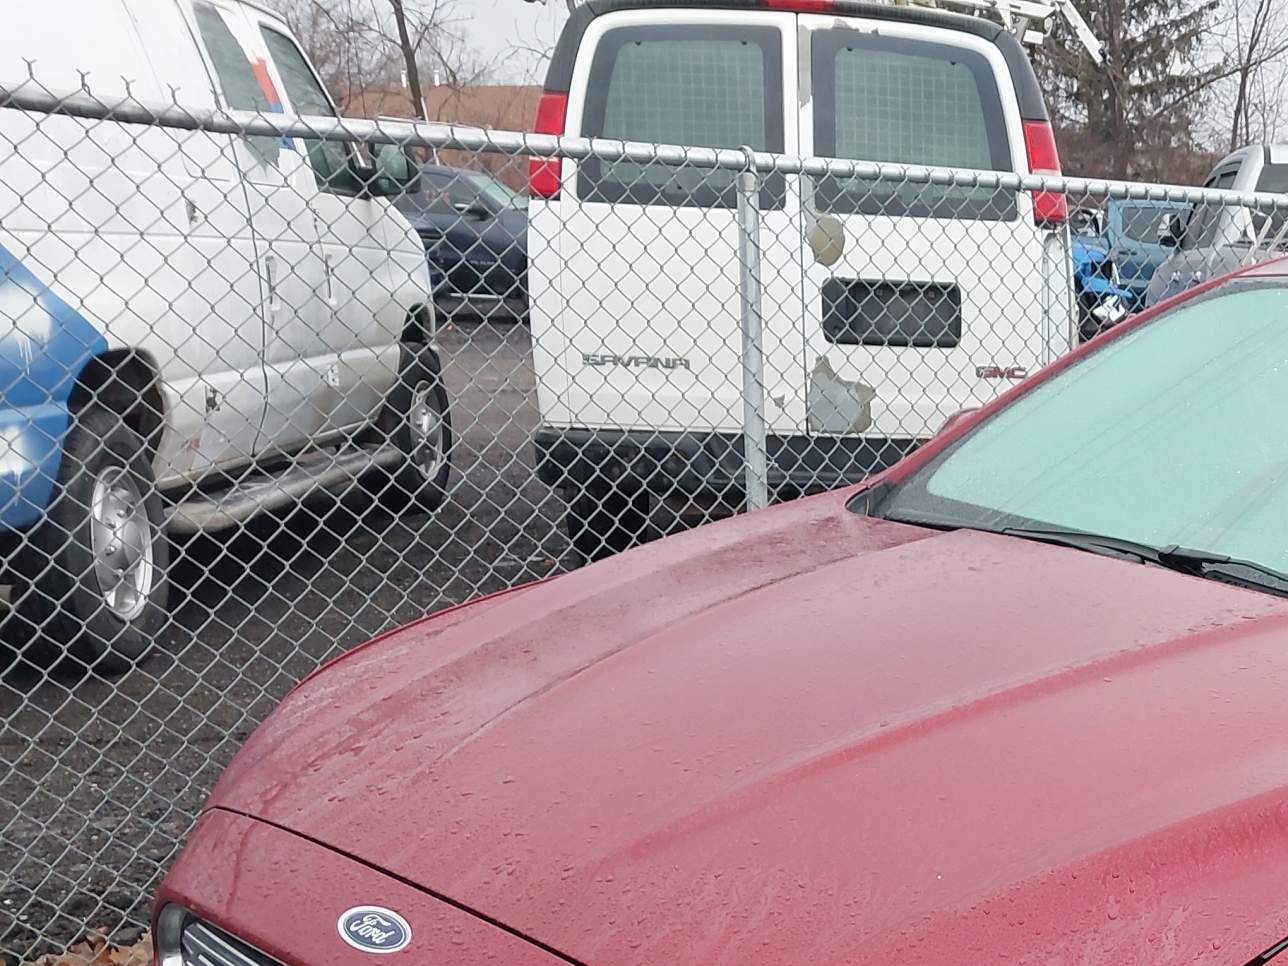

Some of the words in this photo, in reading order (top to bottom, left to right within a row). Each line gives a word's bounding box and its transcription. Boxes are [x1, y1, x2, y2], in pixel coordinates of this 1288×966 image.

[582, 354, 690, 369] SAVANA
[976, 366, 1026, 379] GMC
[349, 914, 395, 944] Ford
